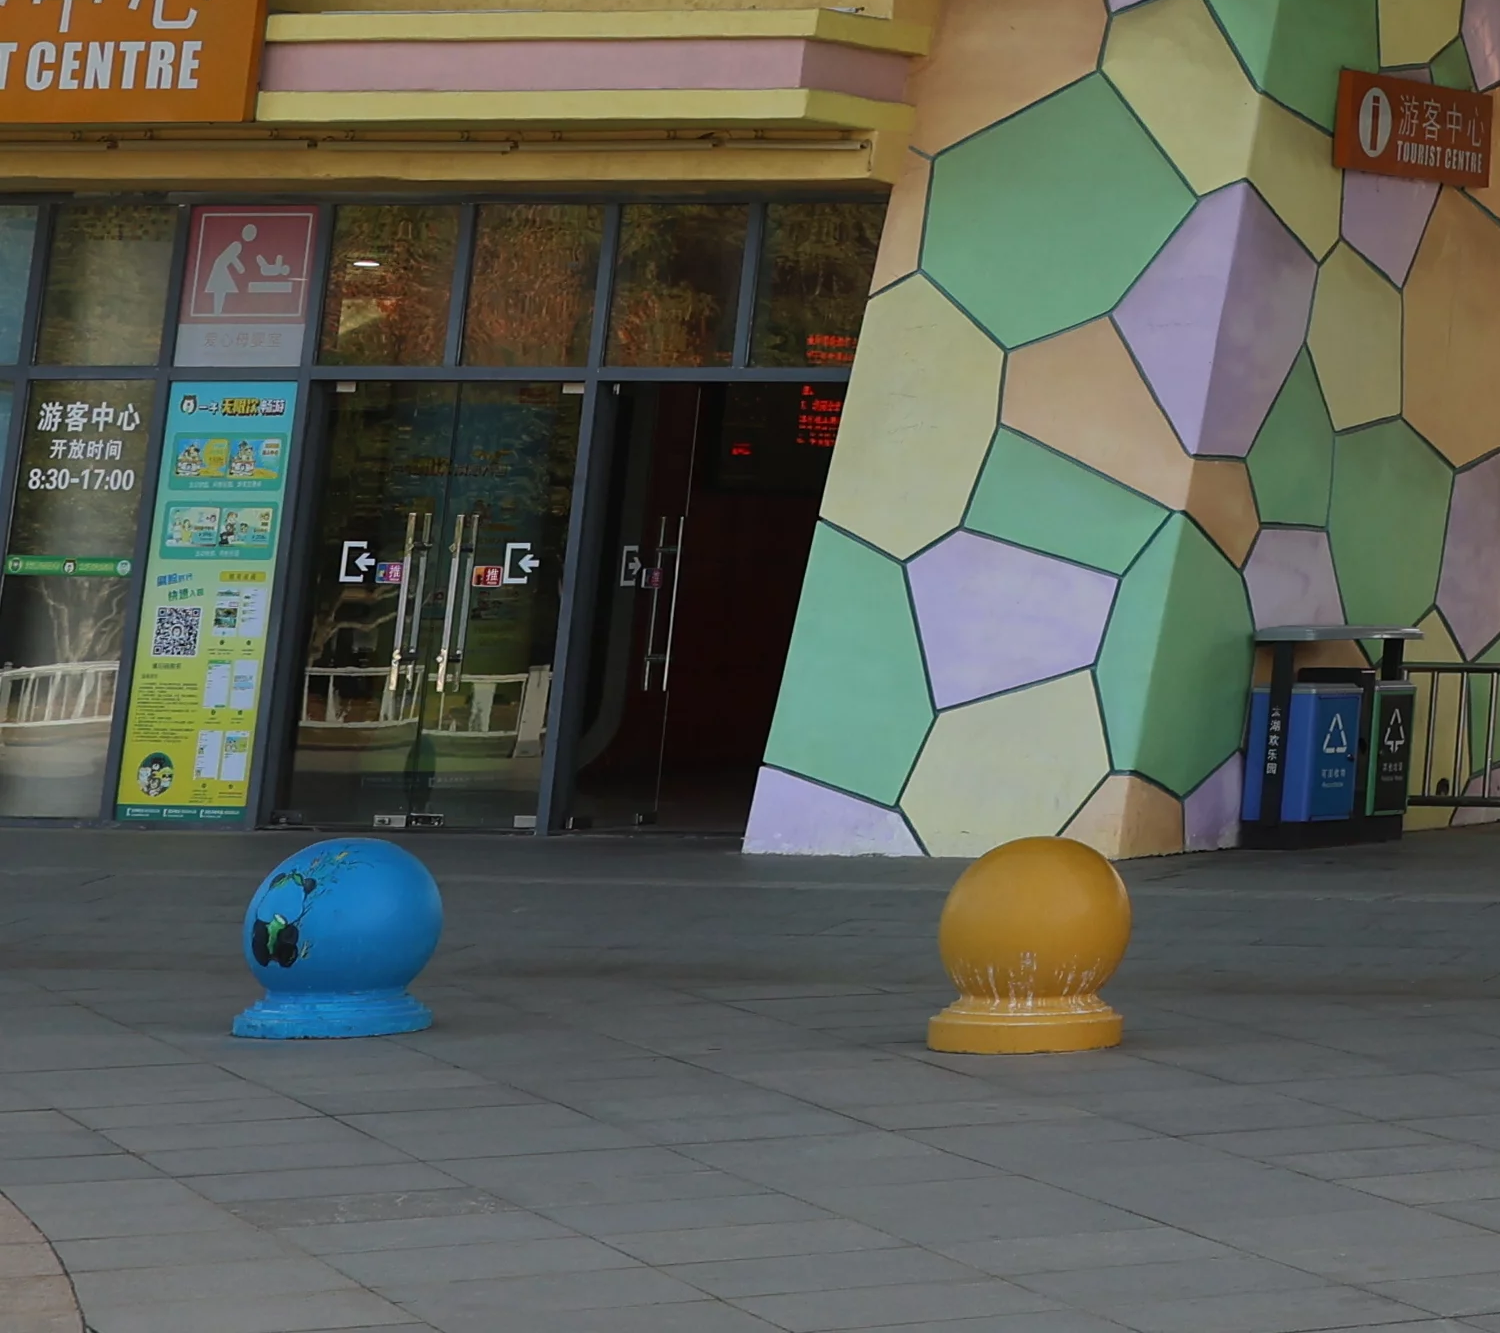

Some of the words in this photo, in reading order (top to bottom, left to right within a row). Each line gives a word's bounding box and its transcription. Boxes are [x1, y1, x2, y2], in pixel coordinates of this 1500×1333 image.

[25, 41, 202, 90] CENTRE
[1398, 93, 1485, 148] 游客中心
[1397, 140, 1442, 169] TOURIST
[1444, 147, 1483, 174] CENTRE
[204, 331, 282, 348] 爱心母婴室
[37, 401, 141, 432] 游客中心
[49, 440, 123, 461] 开放时间
[28, 468, 135, 490] 8:30-17:00
[1266, 706, 1282, 775] 太湖欢乐园
